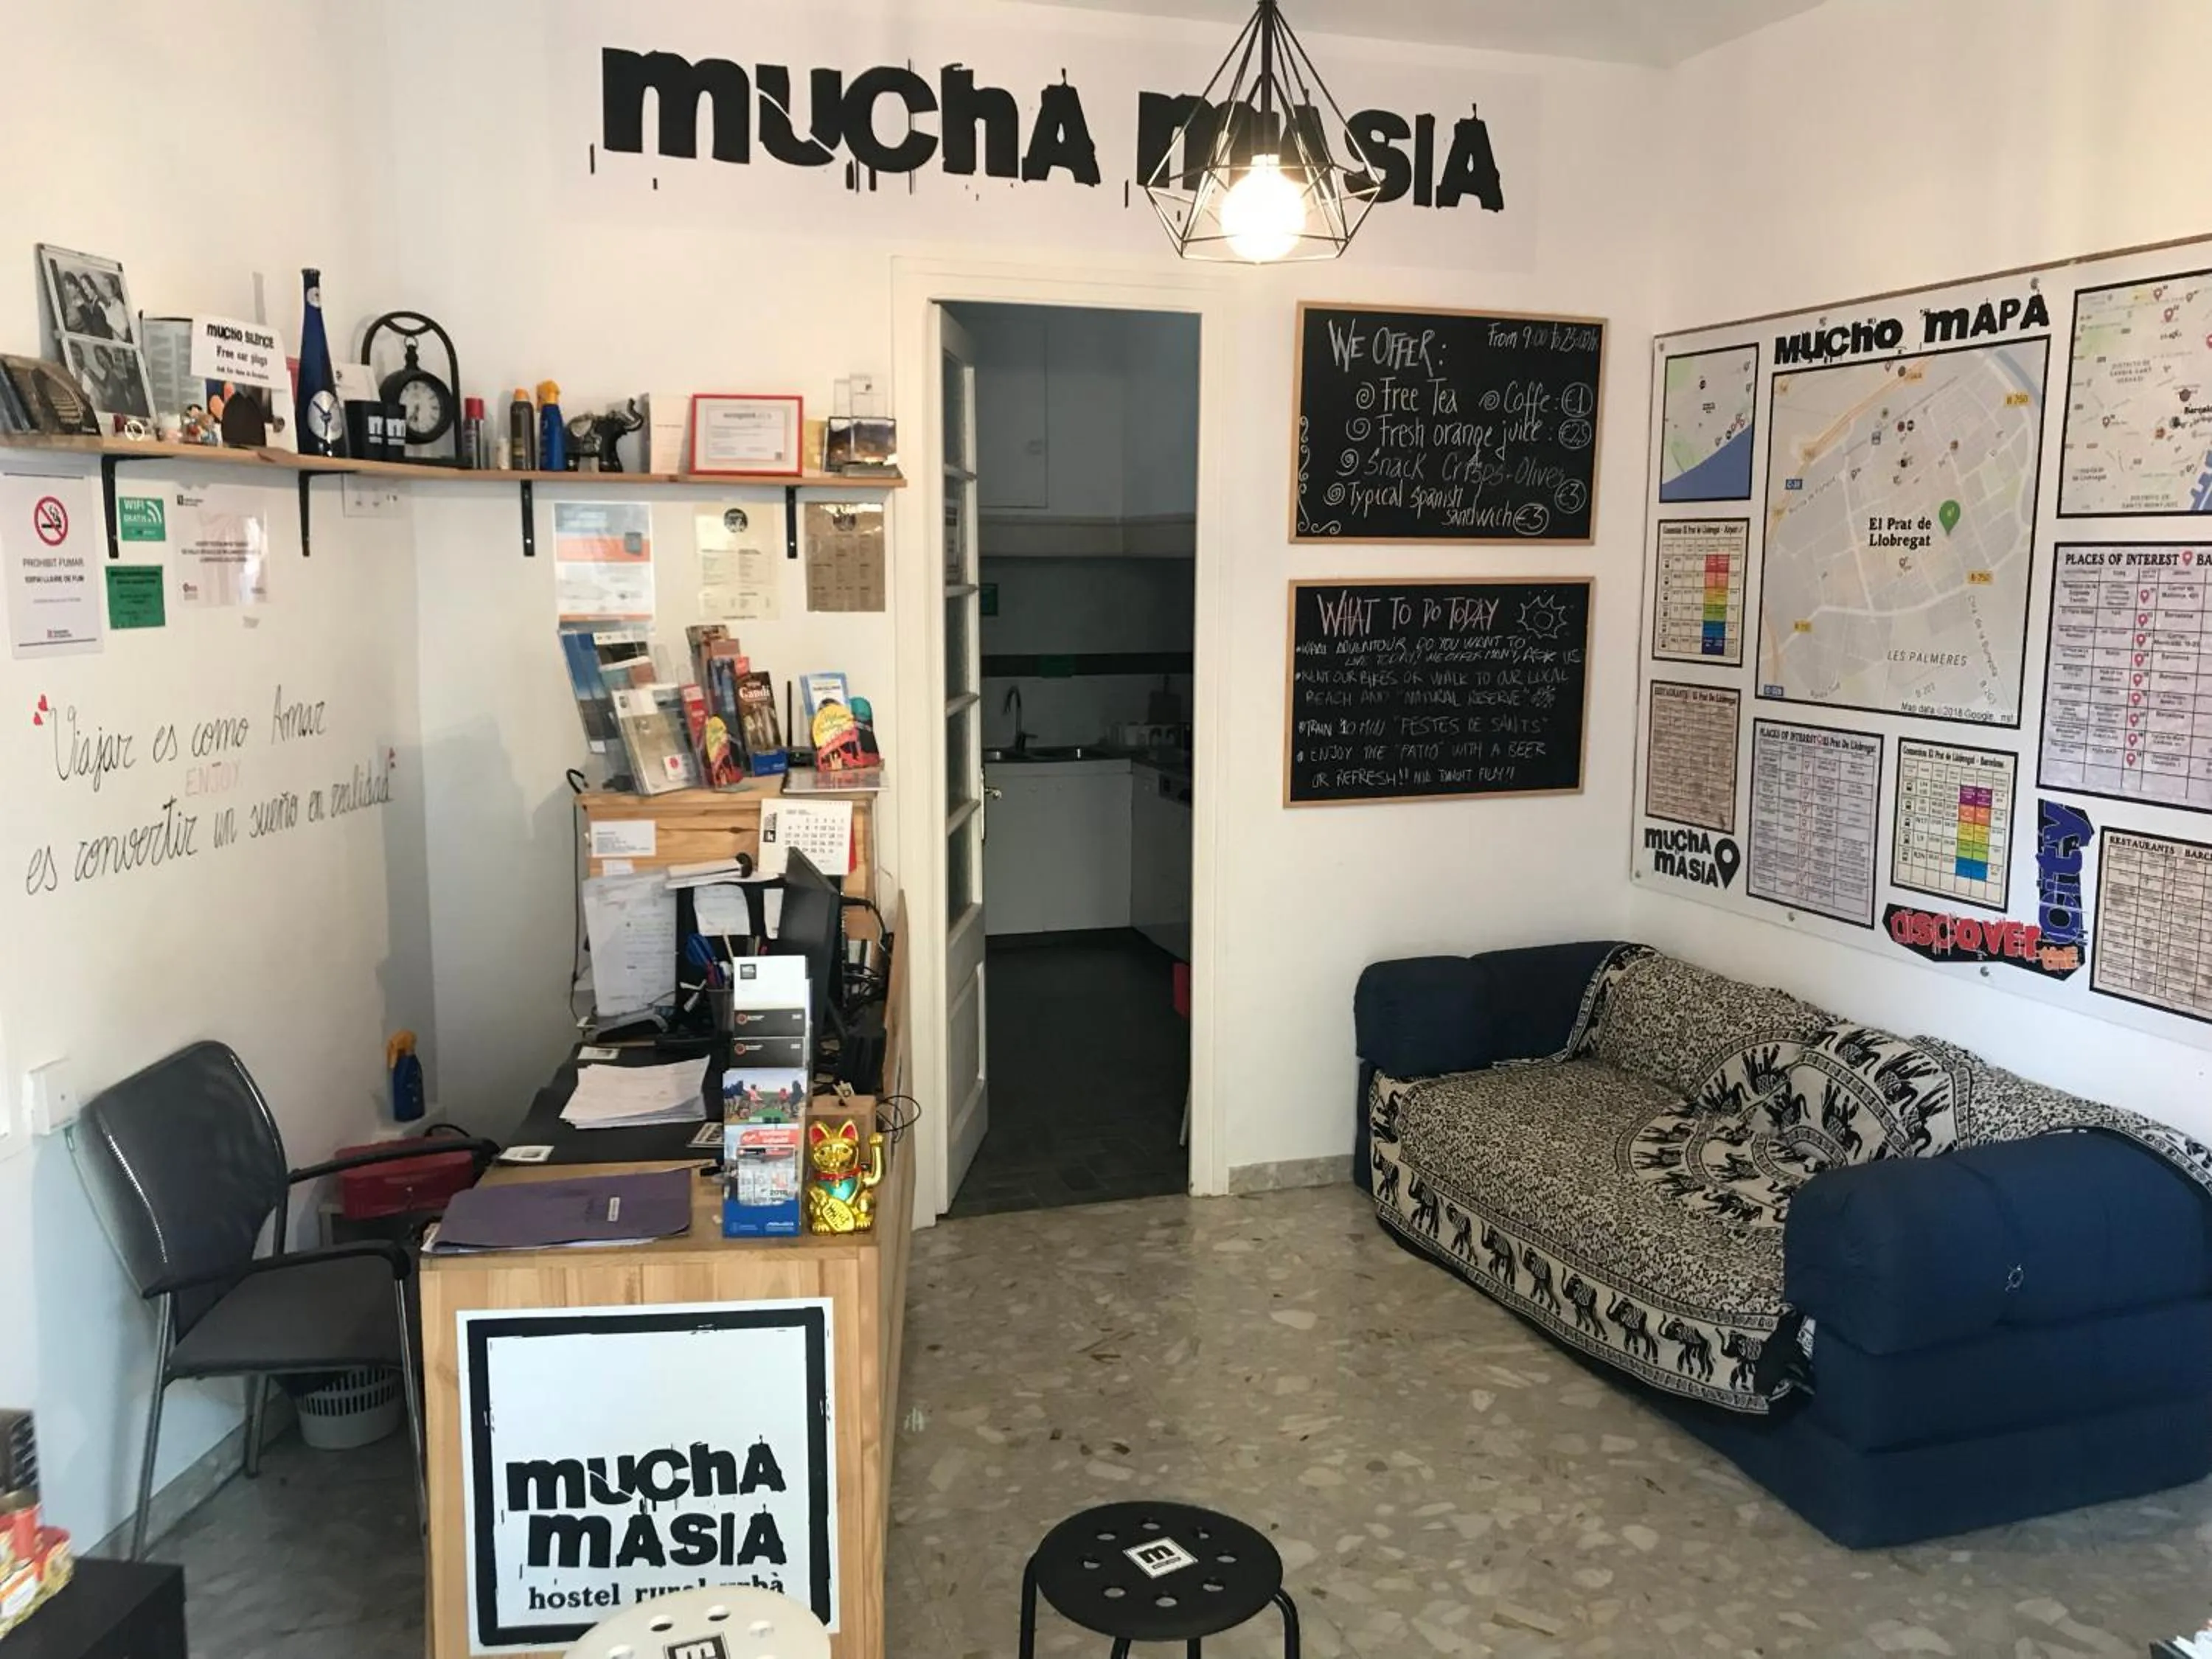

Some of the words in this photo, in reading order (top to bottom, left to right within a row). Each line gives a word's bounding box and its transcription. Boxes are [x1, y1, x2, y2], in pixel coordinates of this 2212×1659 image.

[1329, 319, 1366, 372] WE
[1488, 322, 1517, 349] From
[1380, 378, 1419, 411] Free
[1427, 378, 1457, 415] Tea
[1376, 414, 1425, 448] Fresh
[1433, 422, 1492, 456] orange
[1365, 448, 1426, 481] Snack
[124, 499, 145, 510] WIFI
[1348, 480, 1403, 518] Typical
[1869, 517, 1882, 530] El
[1888, 518, 1912, 530] Prat
[1918, 516, 1932, 530] de
[1869, 534, 1931, 549] Llobregat
[2065, 554, 2104, 566] PLACES
[2109, 554, 2123, 566] OF
[2126, 554, 2180, 566] INTEREST
[1317, 590, 1380, 637] WHAT
[1388, 597, 1411, 630] TO
[1444, 597, 1499, 631] TODAY
[1440, 637, 1458, 650] YOU
[1506, 636, 1526, 649] TO
[1888, 650, 1905, 661] LES
[1909, 651, 1967, 666] PALMERES
[1475, 672, 1491, 685] TO
[49, 705, 137, 793] Viajar
[153, 723, 177, 763] es
[192, 716, 249, 757] como
[272, 684, 325, 745] Amar
[1310, 745, 1353, 762] ENJOY
[1490, 743, 1500, 758] A
[27, 845, 58, 895] es
[74, 795, 198, 883] convertir
[214, 807, 237, 848] un
[307, 789, 324, 823] en
[2110, 835, 2175, 854] RESTAURANTS
[529, 1584, 620, 1610] hostel
